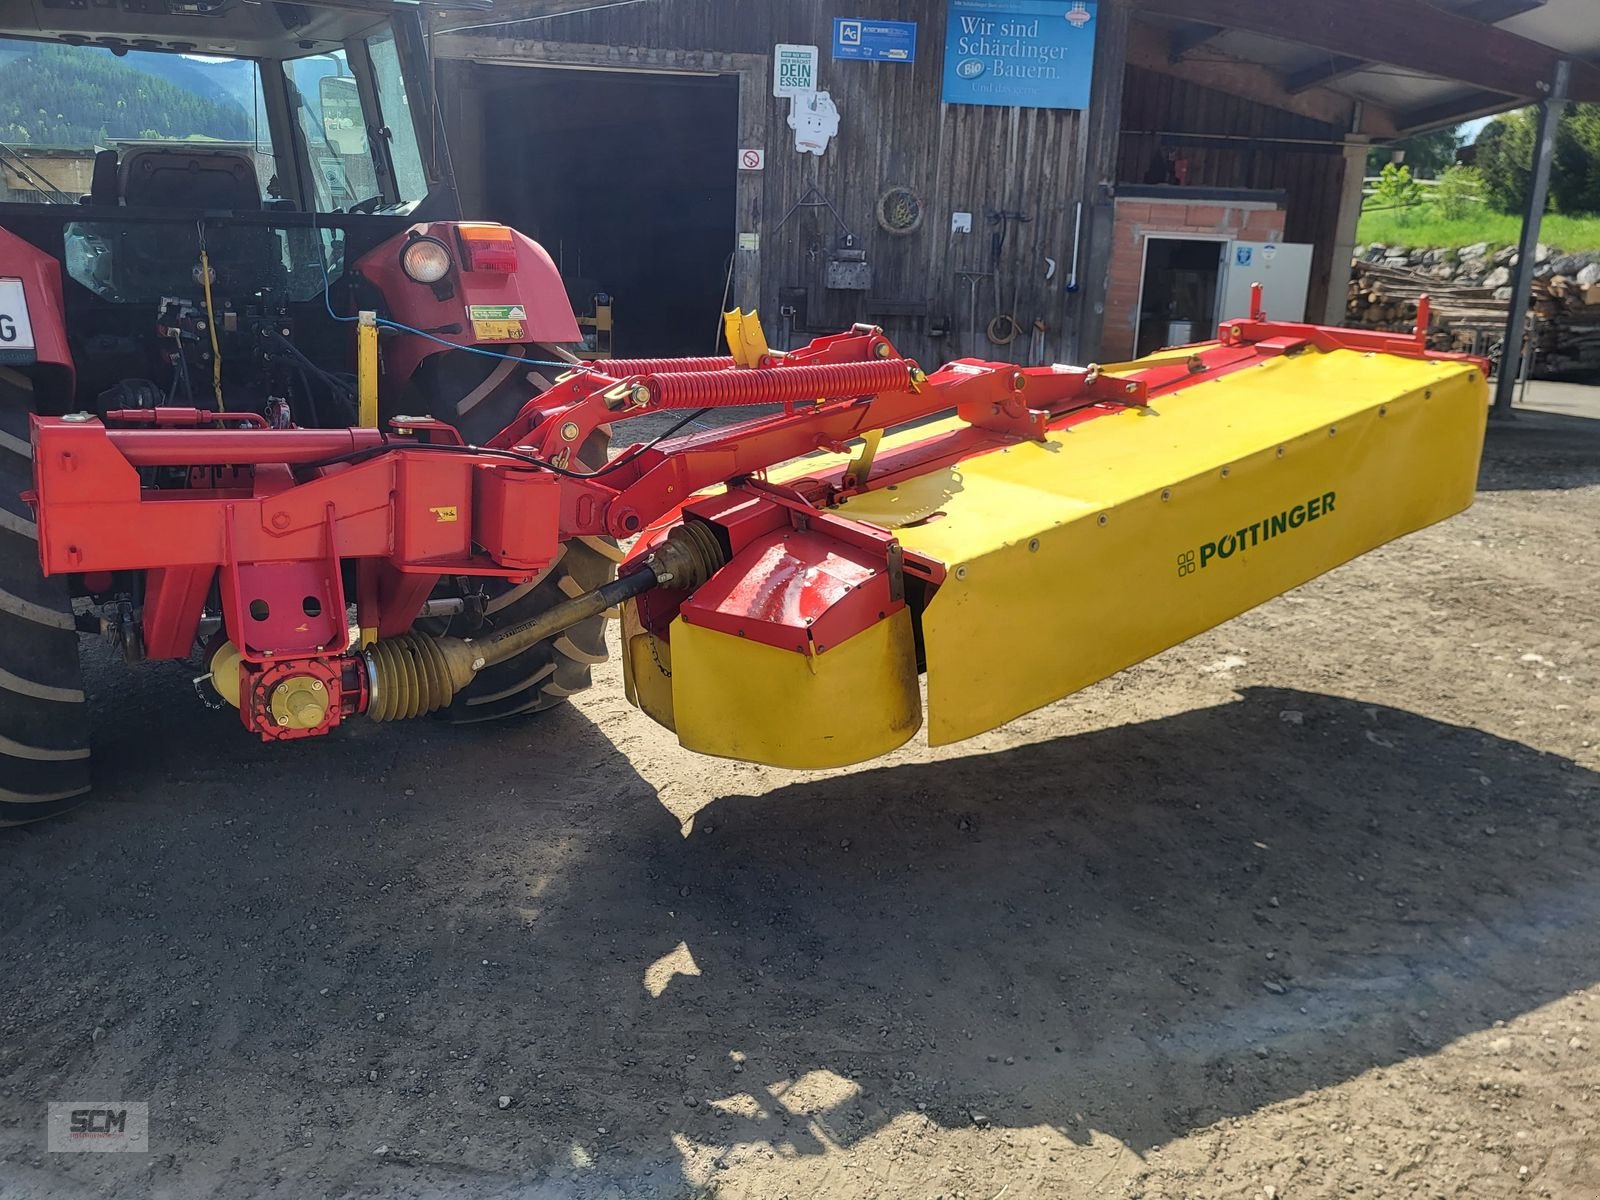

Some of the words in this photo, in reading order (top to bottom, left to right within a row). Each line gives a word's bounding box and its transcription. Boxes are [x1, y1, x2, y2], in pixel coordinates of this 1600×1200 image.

[960, 16, 995, 36] Wir
[1000, 19, 1039, 38] sind
[958, 37, 1068, 64] Schärdinger
[780, 64, 811, 77] DEIN
[780, 77, 811, 88] ESSEN
[1199, 491, 1337, 568] PÖTTINGER
